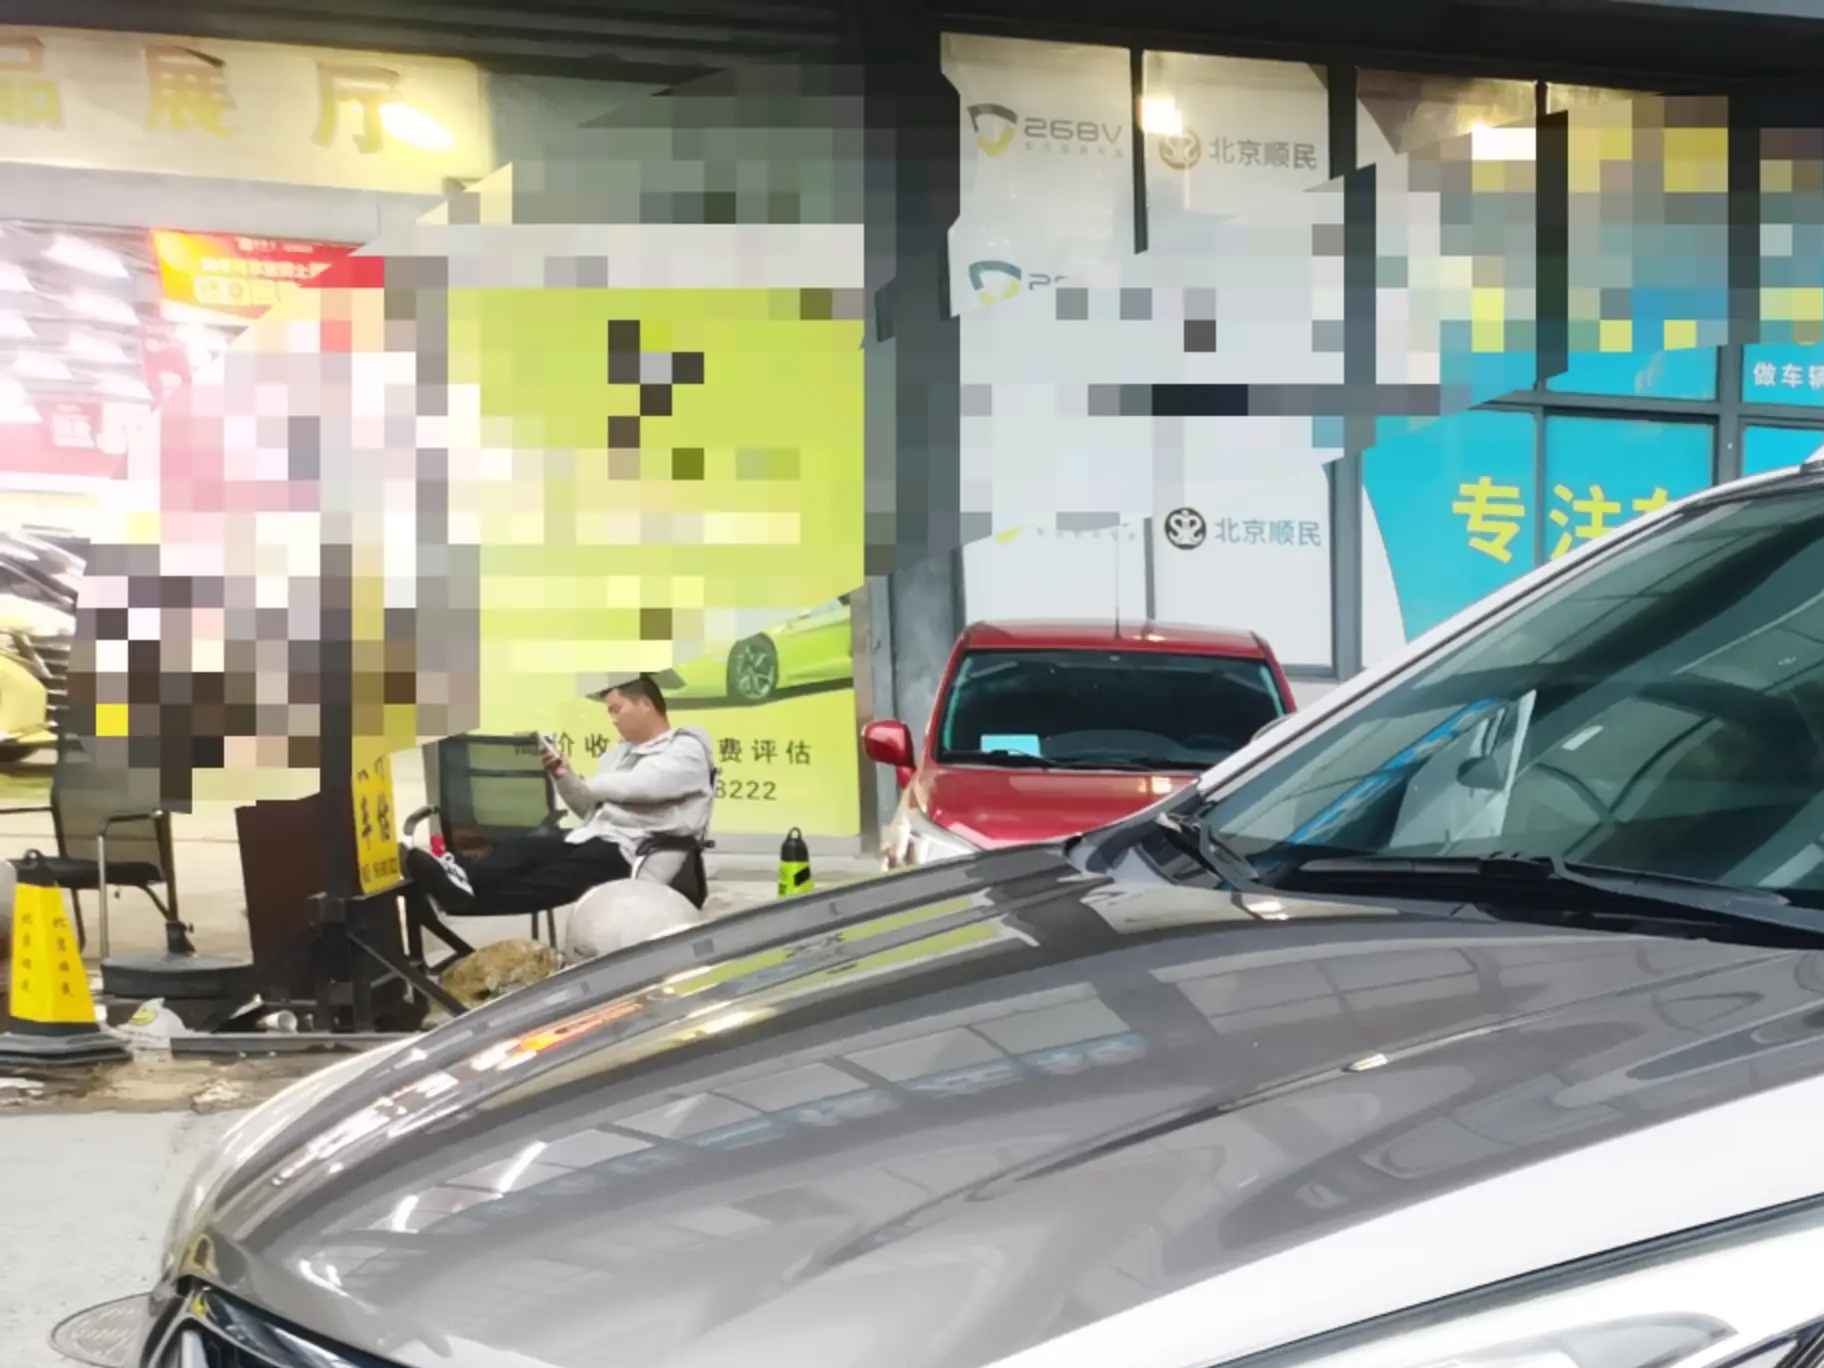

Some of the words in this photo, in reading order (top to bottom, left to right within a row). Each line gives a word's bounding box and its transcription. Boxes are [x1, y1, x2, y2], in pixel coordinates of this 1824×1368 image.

[1024, 116, 1123, 144] 268V
[1209, 136, 1317, 170] 北京顺民
[1214, 518, 1322, 546] 北京顺民
[1452, 476, 1668, 563] 专注
[718, 737, 812, 765] 费评估
